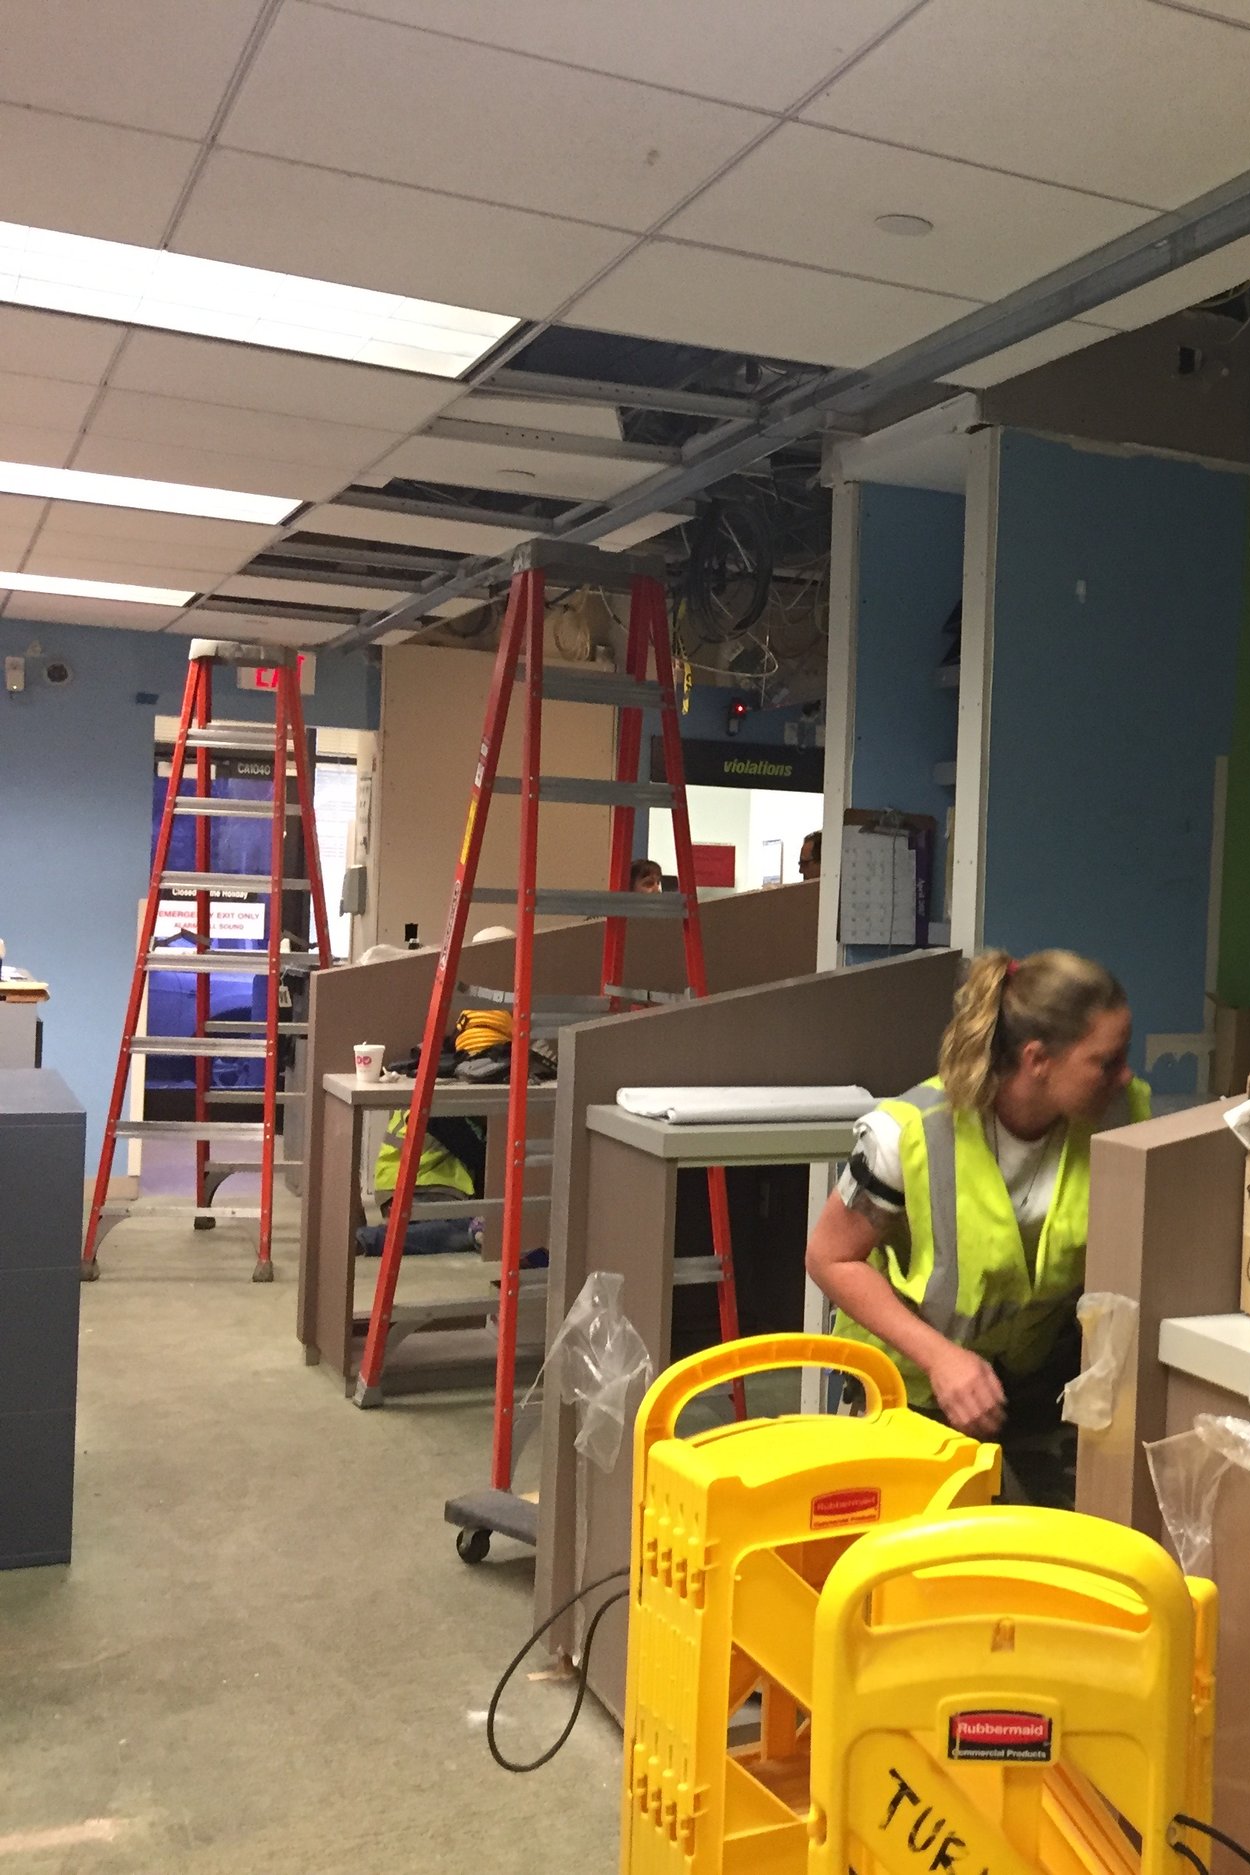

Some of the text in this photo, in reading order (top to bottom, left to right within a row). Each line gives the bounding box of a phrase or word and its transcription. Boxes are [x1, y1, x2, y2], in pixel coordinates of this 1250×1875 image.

[723, 759, 793, 777] violations
[158, 909, 260, 921] EMERGEY EXIT ONLY
[957, 1721, 1045, 1737] Rubbermaid
[951, 1747, 1047, 1760] Commercial Products
[878, 1767, 990, 1875] TUR
